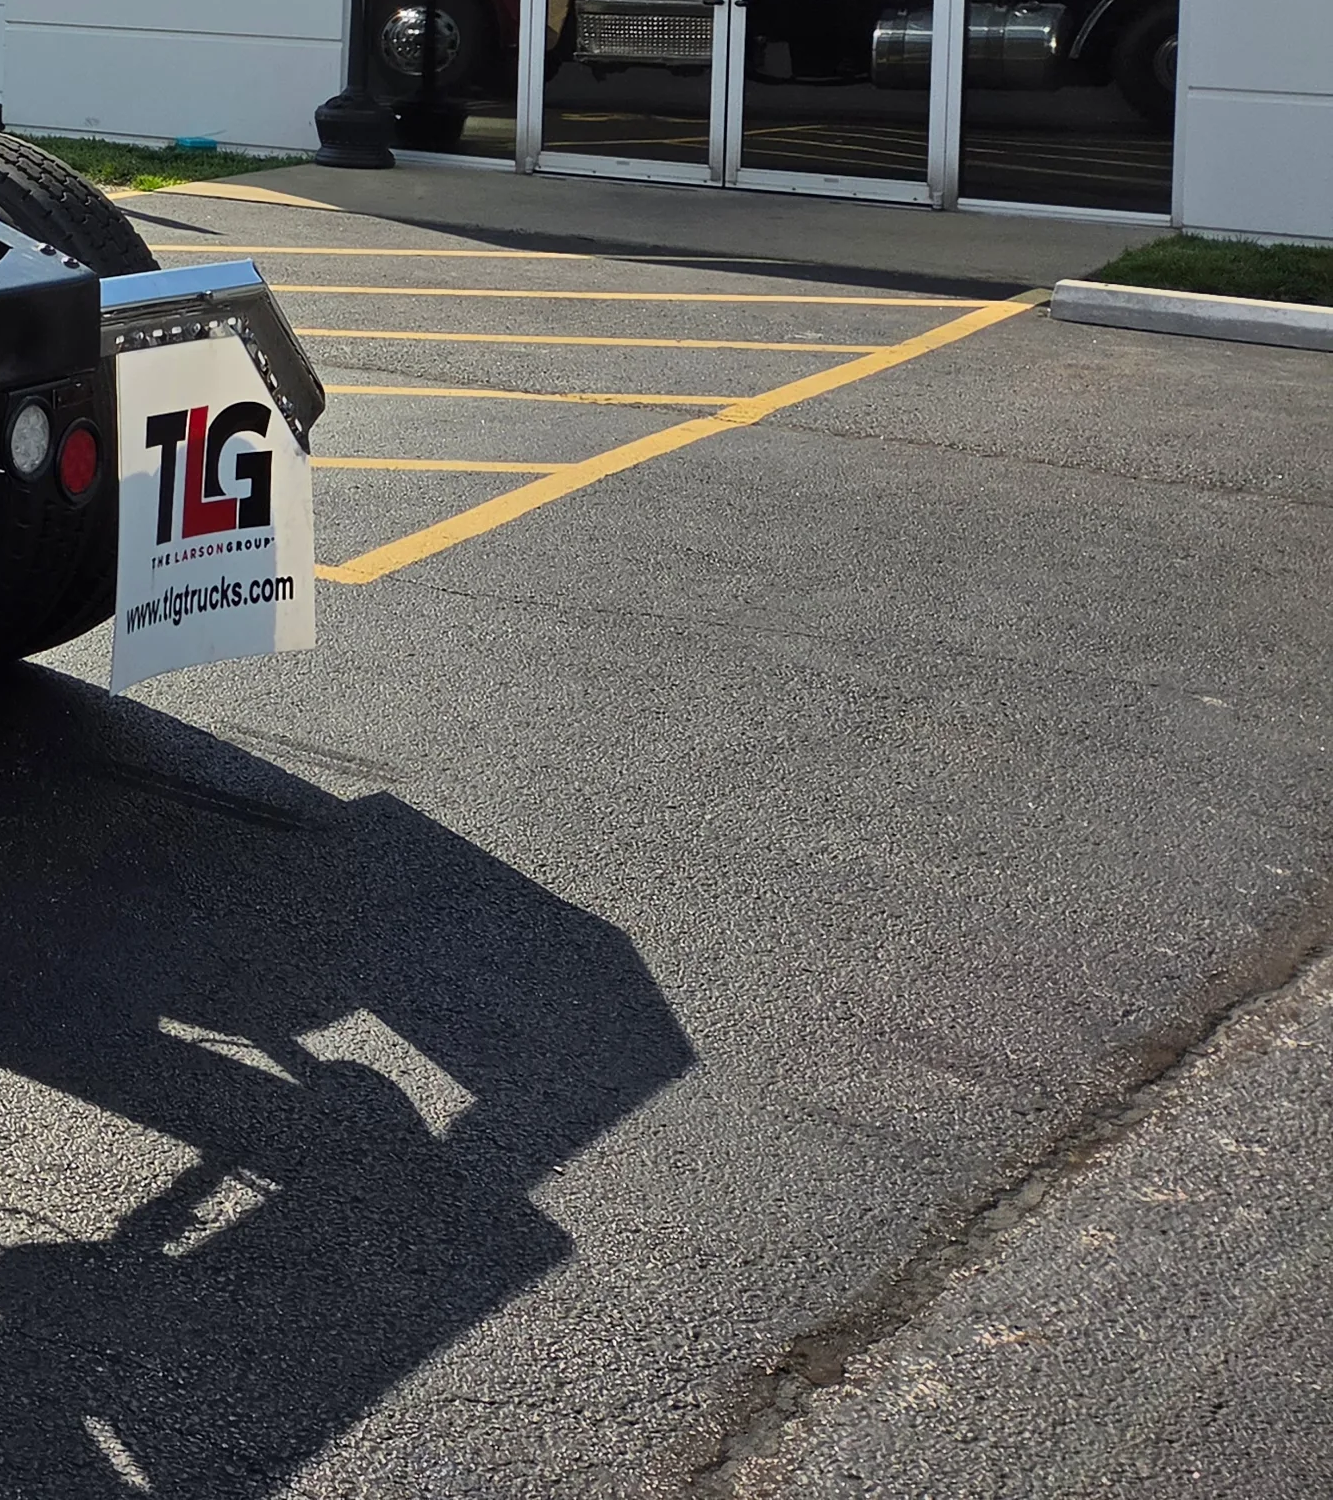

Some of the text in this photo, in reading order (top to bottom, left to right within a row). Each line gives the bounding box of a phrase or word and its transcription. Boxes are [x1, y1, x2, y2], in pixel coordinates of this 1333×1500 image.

[145, 401, 273, 546] TLG
[151, 553, 171, 570] THE
[126, 575, 294, 634] www.tlgtrucks.com
